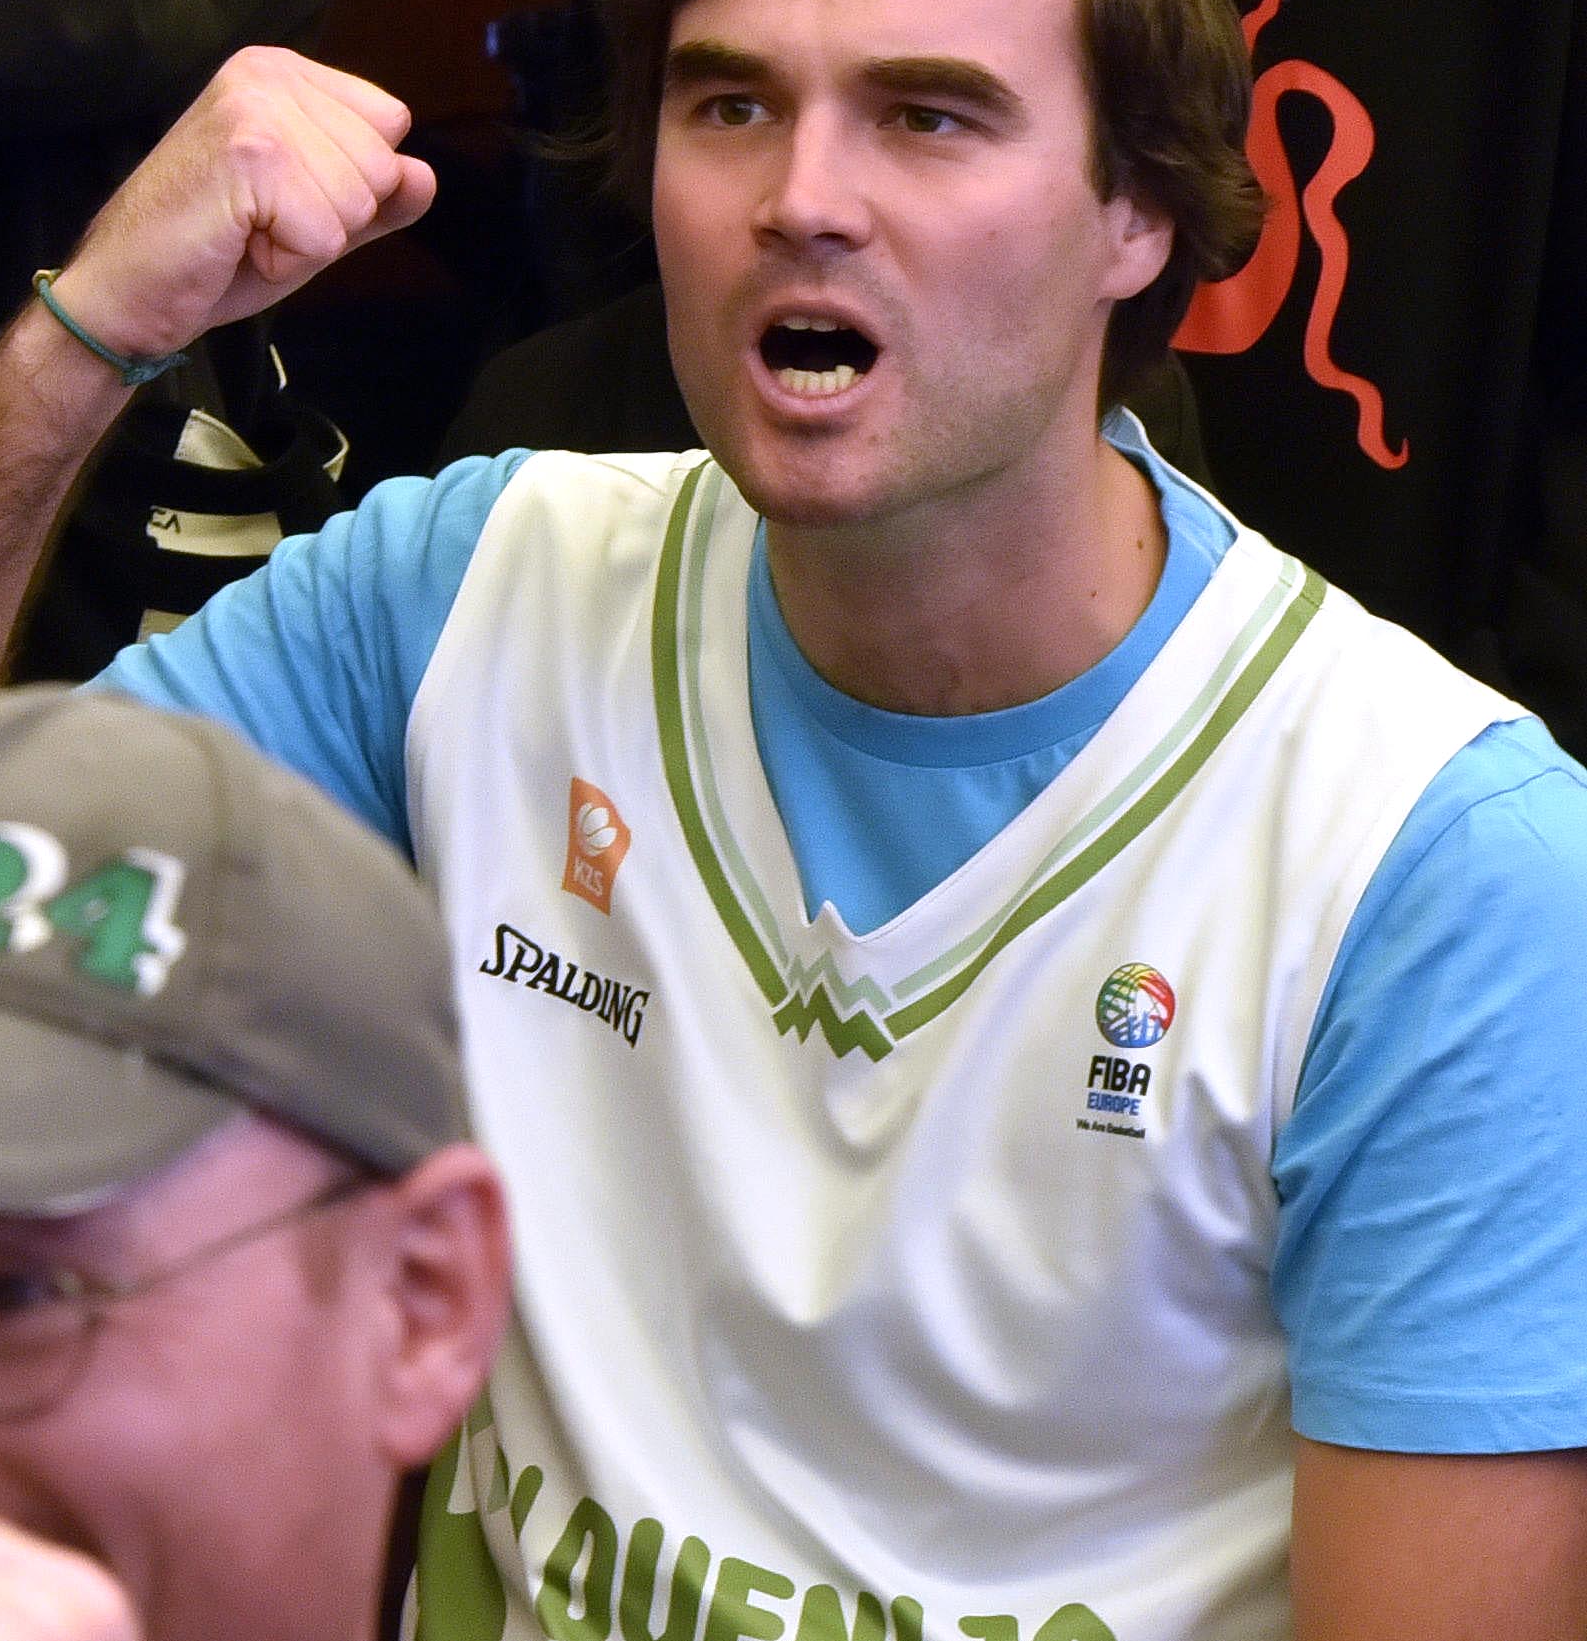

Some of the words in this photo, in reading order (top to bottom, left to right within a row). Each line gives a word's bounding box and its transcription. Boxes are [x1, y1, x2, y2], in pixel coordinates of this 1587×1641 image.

[573, 858, 605, 898] KZS
[479, 923, 651, 1049] SPALDING
[1087, 1054, 1152, 1096] FIBA
[1086, 1091, 1142, 1116] EUROPE
